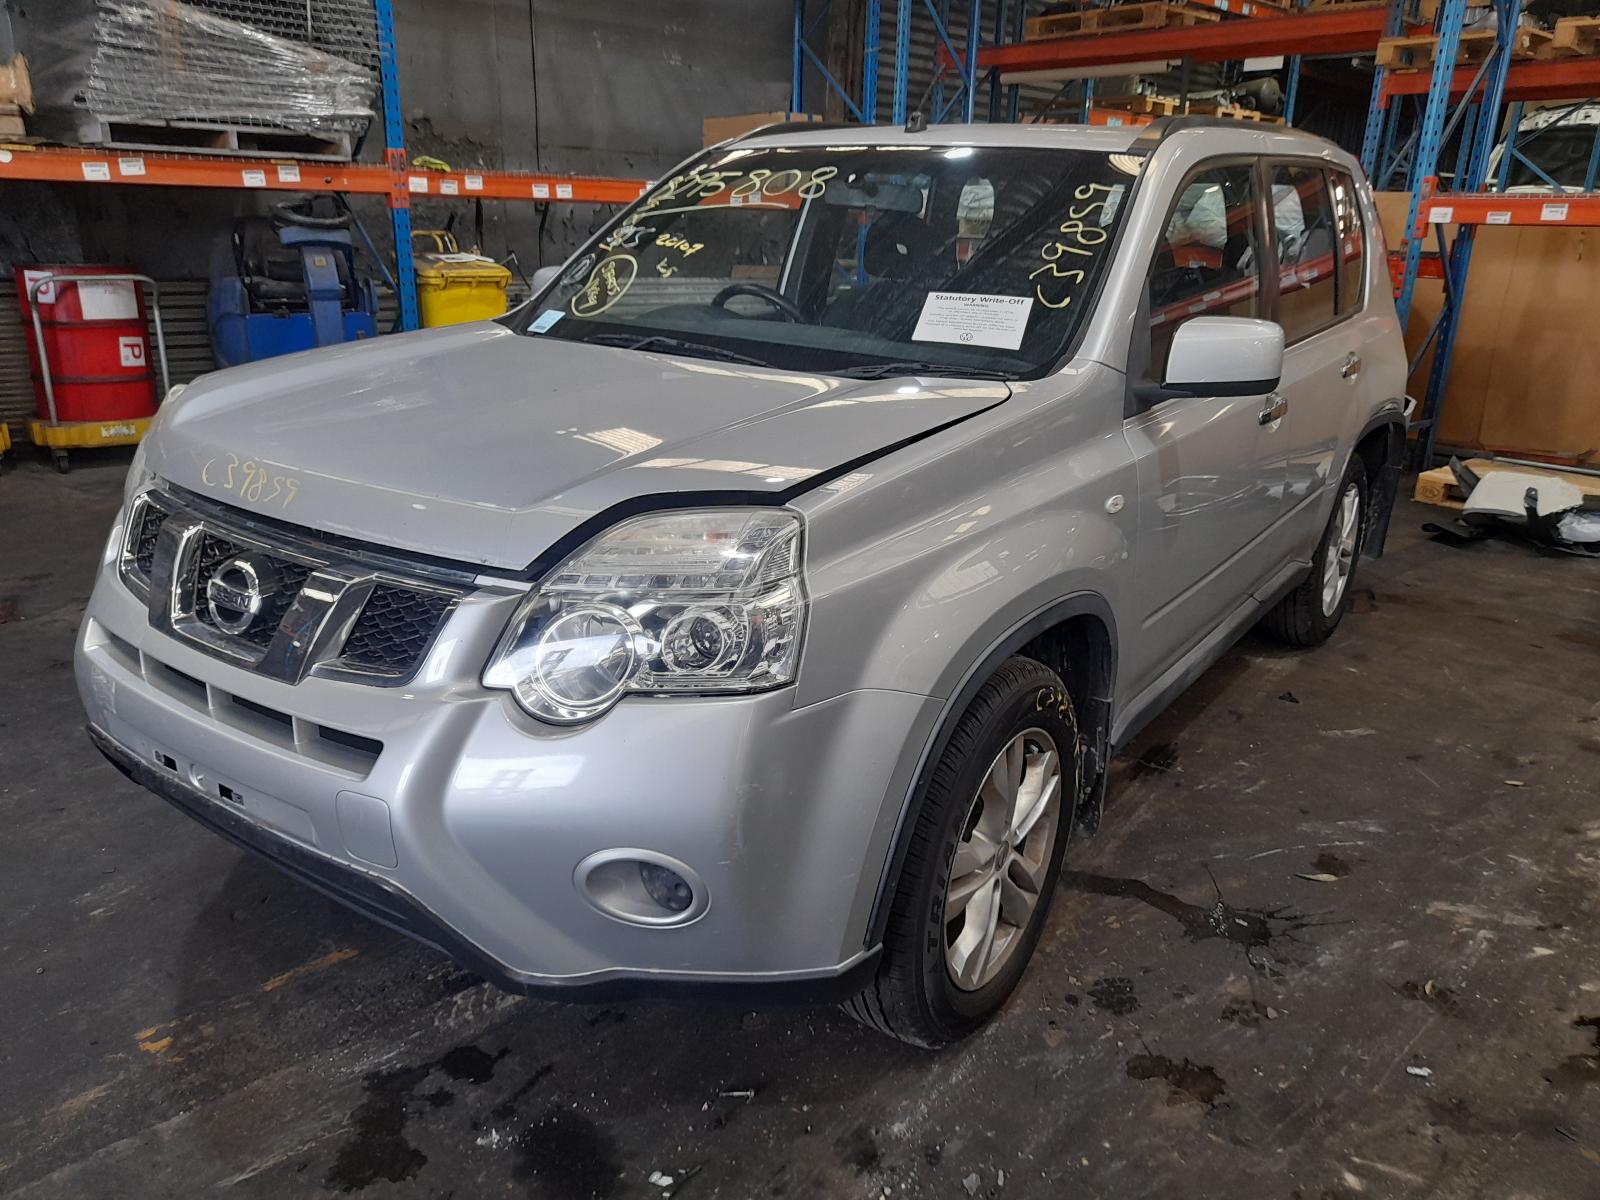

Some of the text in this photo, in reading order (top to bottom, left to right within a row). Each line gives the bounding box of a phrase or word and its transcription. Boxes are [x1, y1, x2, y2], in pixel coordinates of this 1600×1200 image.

[935, 294, 1025, 305] Statutory Write-Off
[123, 343, 142, 359] P
